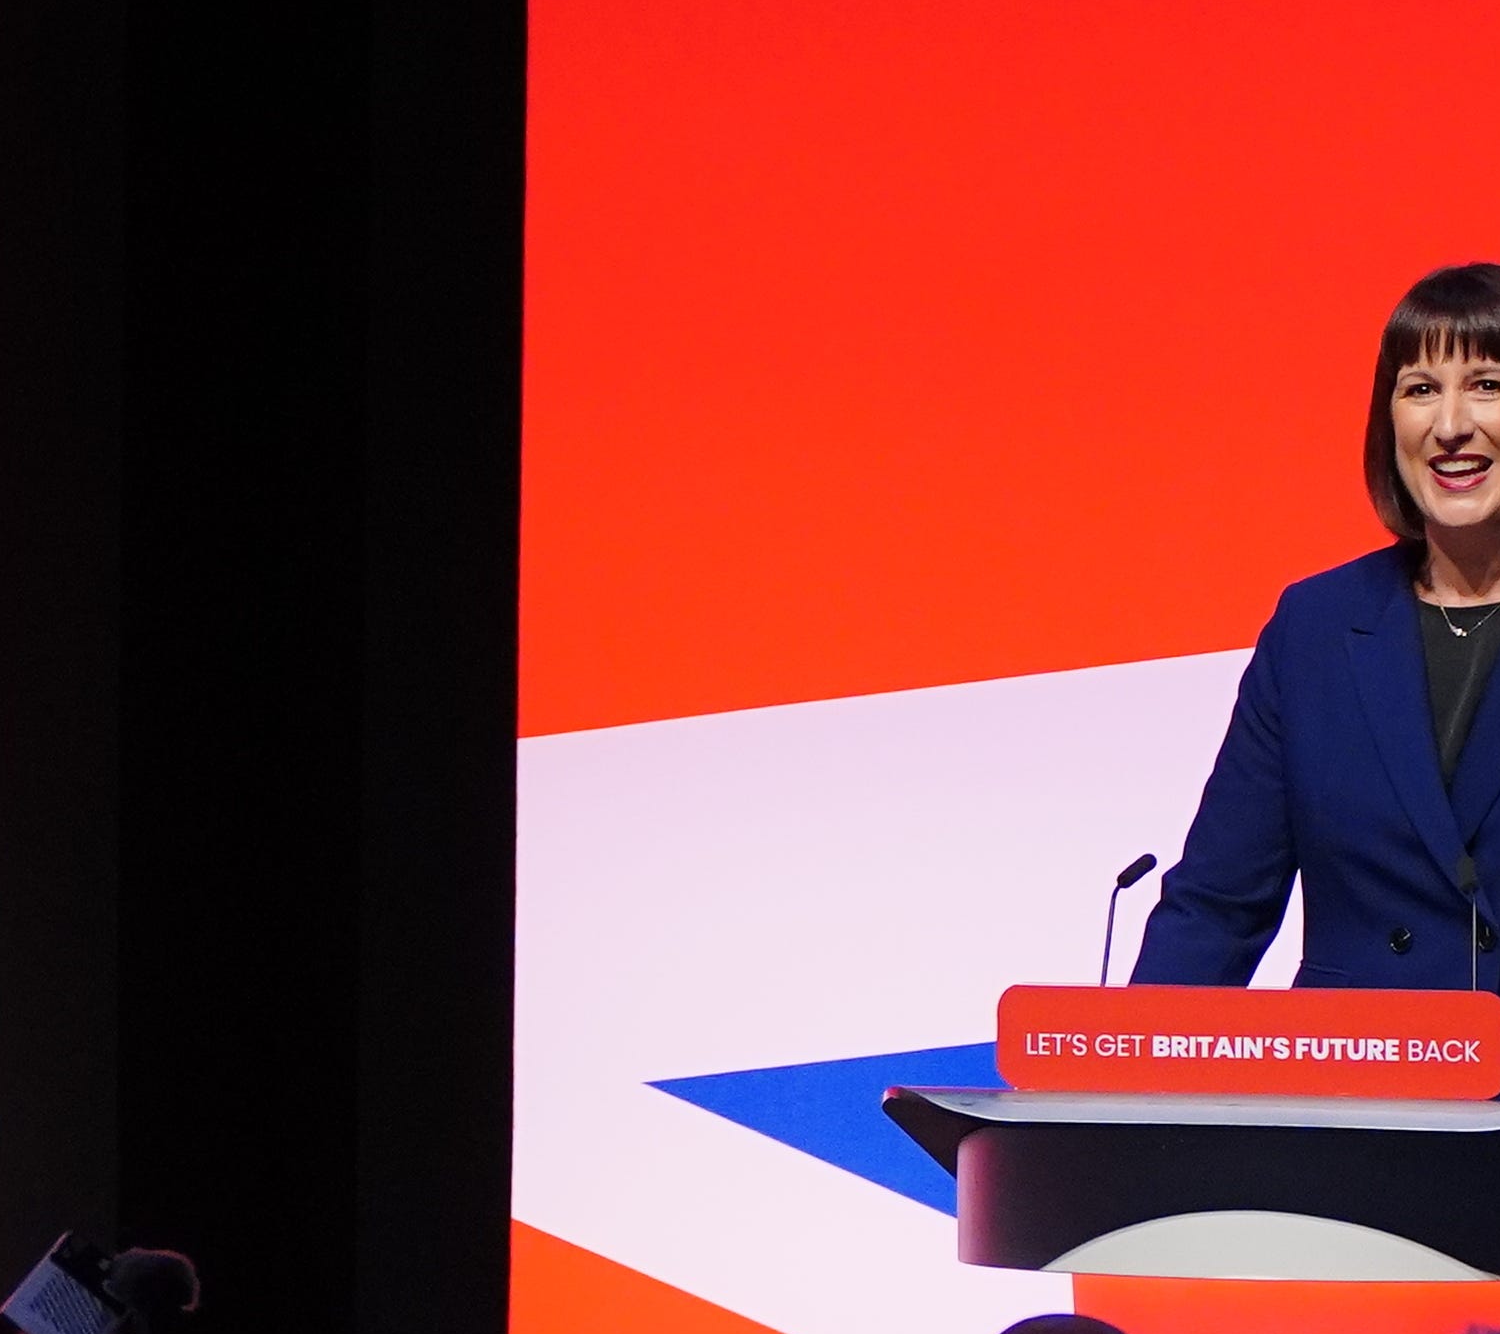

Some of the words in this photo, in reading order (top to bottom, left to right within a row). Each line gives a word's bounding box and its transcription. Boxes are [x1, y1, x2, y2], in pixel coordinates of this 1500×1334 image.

[1026, 1033, 1088, 1057] LET'S
[1094, 1034, 1146, 1058] GET
[1152, 1035, 1291, 1061] BRITAIN'S
[1295, 1037, 1400, 1062] FUTURE
[1407, 1039, 1481, 1064] BACK
